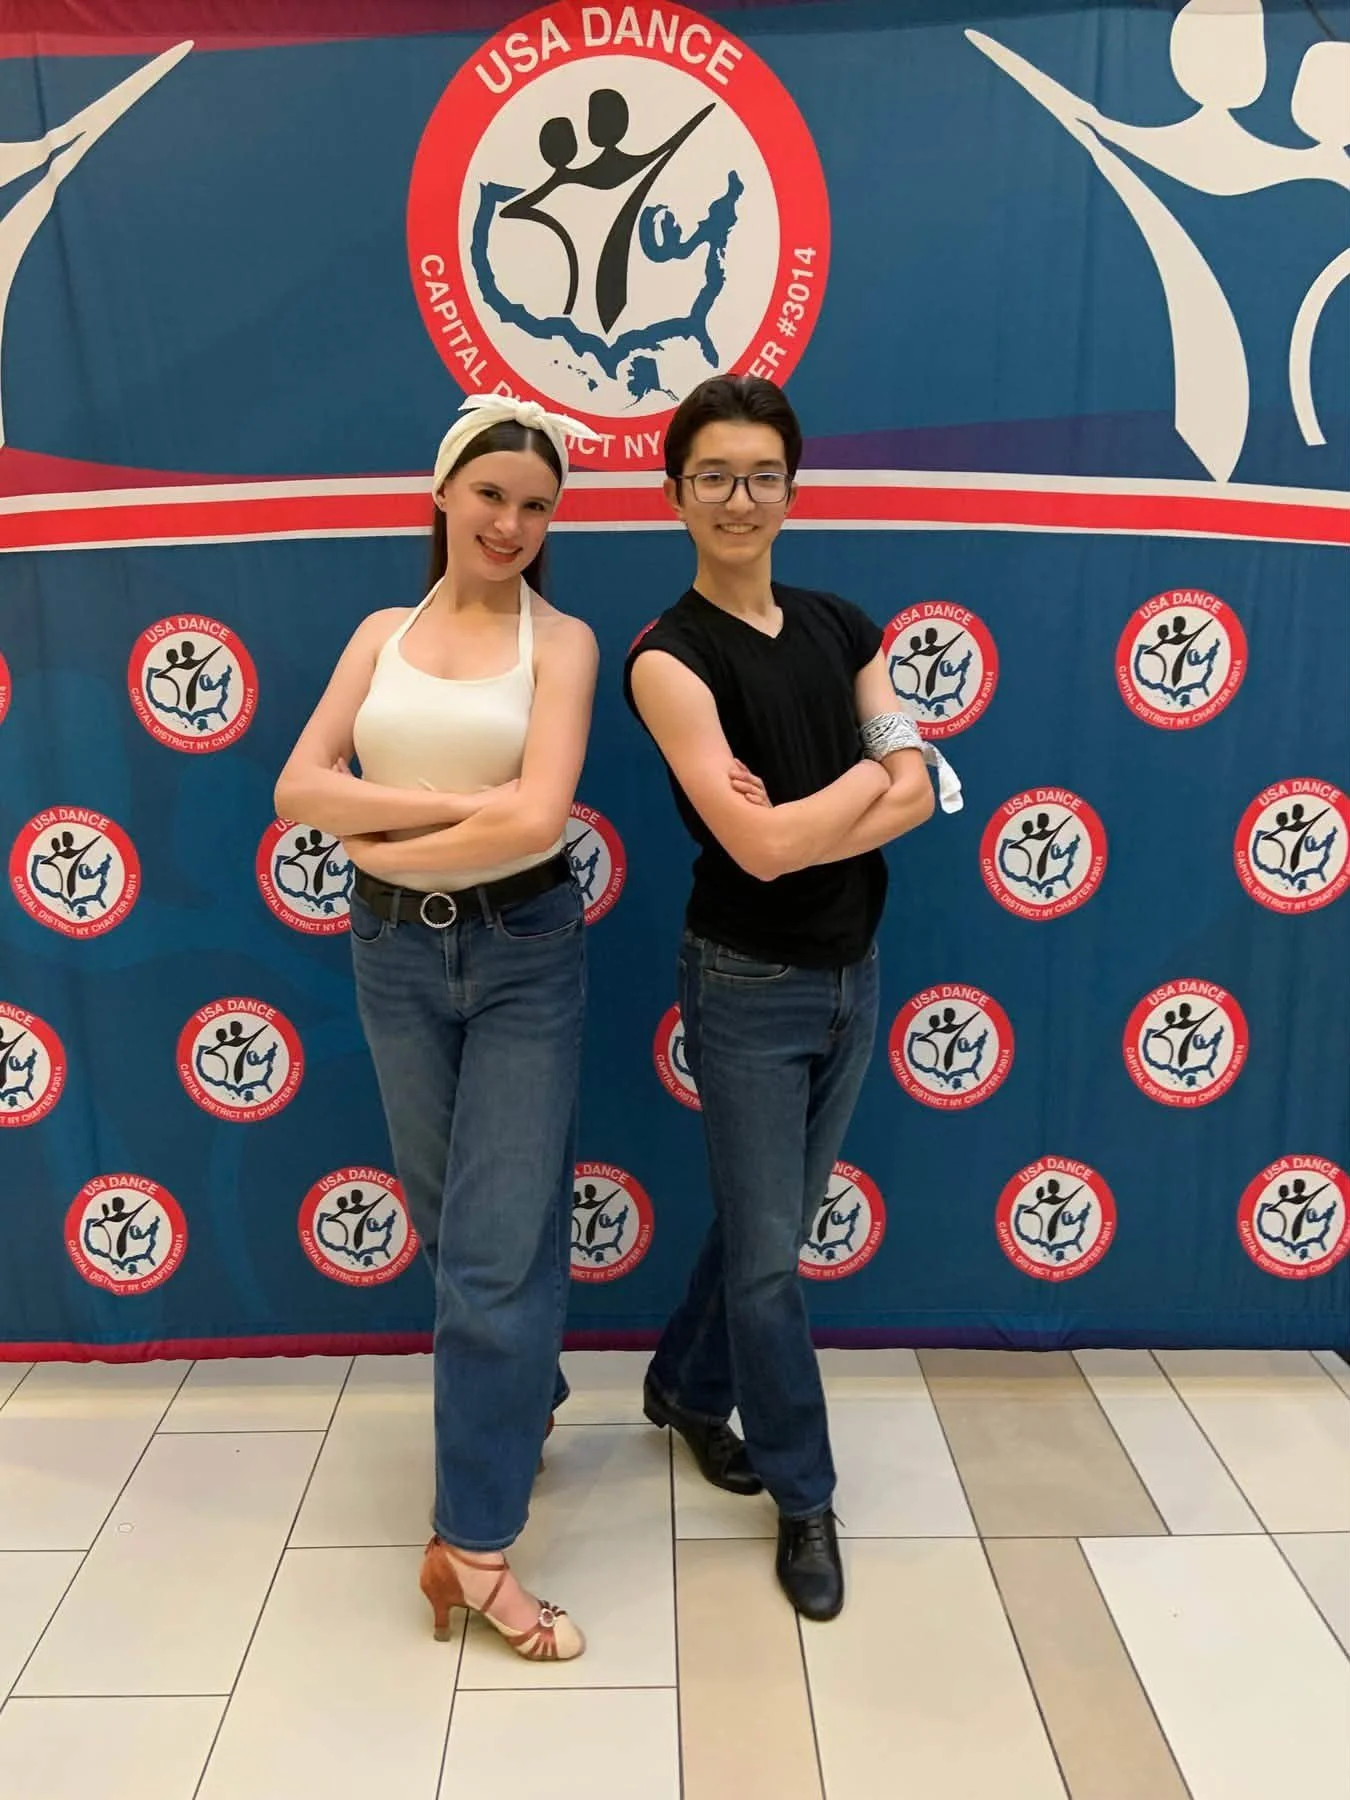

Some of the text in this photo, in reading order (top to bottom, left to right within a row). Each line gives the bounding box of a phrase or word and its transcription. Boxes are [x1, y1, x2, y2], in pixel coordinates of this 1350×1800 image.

[476, 6, 743, 94] USA DANCE
[420, 254, 487, 388] CAPITAL
[624, 430, 662, 459] NY
[776, 247, 816, 337] #3014
[892, 605, 973, 631] USA DANCE
[1139, 592, 1223, 619] USA DANCE
[145, 618, 230, 643] USA DANCE
[132, 688, 154, 727] CAPITAL
[153, 726, 194, 749] DISTRICT
[212, 715, 248, 746] CHAPTER
[947, 699, 984, 732] CHAPTER
[1003, 791, 1082, 815] USA DANCE
[1258, 781, 1341, 806] USA DANCE
[32, 809, 110, 831] USA DANCE
[571, 804, 600, 825] NCE
[983, 858, 1001, 895] CAPITAL
[1001, 894, 1040, 917] DISTRICT
[1055, 884, 1093, 912] CHAPTER
[15, 876, 38, 913] CAPITAL
[38, 911, 75, 934] DISTRICT
[91, 902, 128, 932] CHAPTER
[260, 874, 281, 911] CAPITAL
[280, 910, 320, 931] DISTRICT
[585, 893, 614, 922] HAPTER
[912, 986, 990, 1010] USA DANCE
[1147, 982, 1226, 1006] USA DANCE
[0, 1006, 34, 1027] ANCE
[196, 1000, 276, 1023] USA DANCE
[891, 1050, 908, 1086] CAPITAL
[1126, 1047, 1145, 1083] CAPITAL
[180, 1064, 201, 1098] CAPITAL
[202, 1096, 240, 1119] DISTRICT
[257, 1087, 292, 1116] CHAPTER
[318, 1169, 396, 1192] USA DANCE
[583, 1164, 630, 1184] DANCE
[833, 1162, 862, 1181] NCE
[1018, 1158, 1093, 1182] USA DANCE
[1263, 1158, 1340, 1180] USA DANCE
[84, 1177, 159, 1196] USA DANCE
[999, 1221, 1017, 1257] CAPITAL
[68, 1240, 89, 1273] CAPITAL
[141, 1259, 177, 1289] CHAPTER
[302, 1230, 323, 1265] CAPITAL
[323, 1262, 360, 1282] DISTRICT
